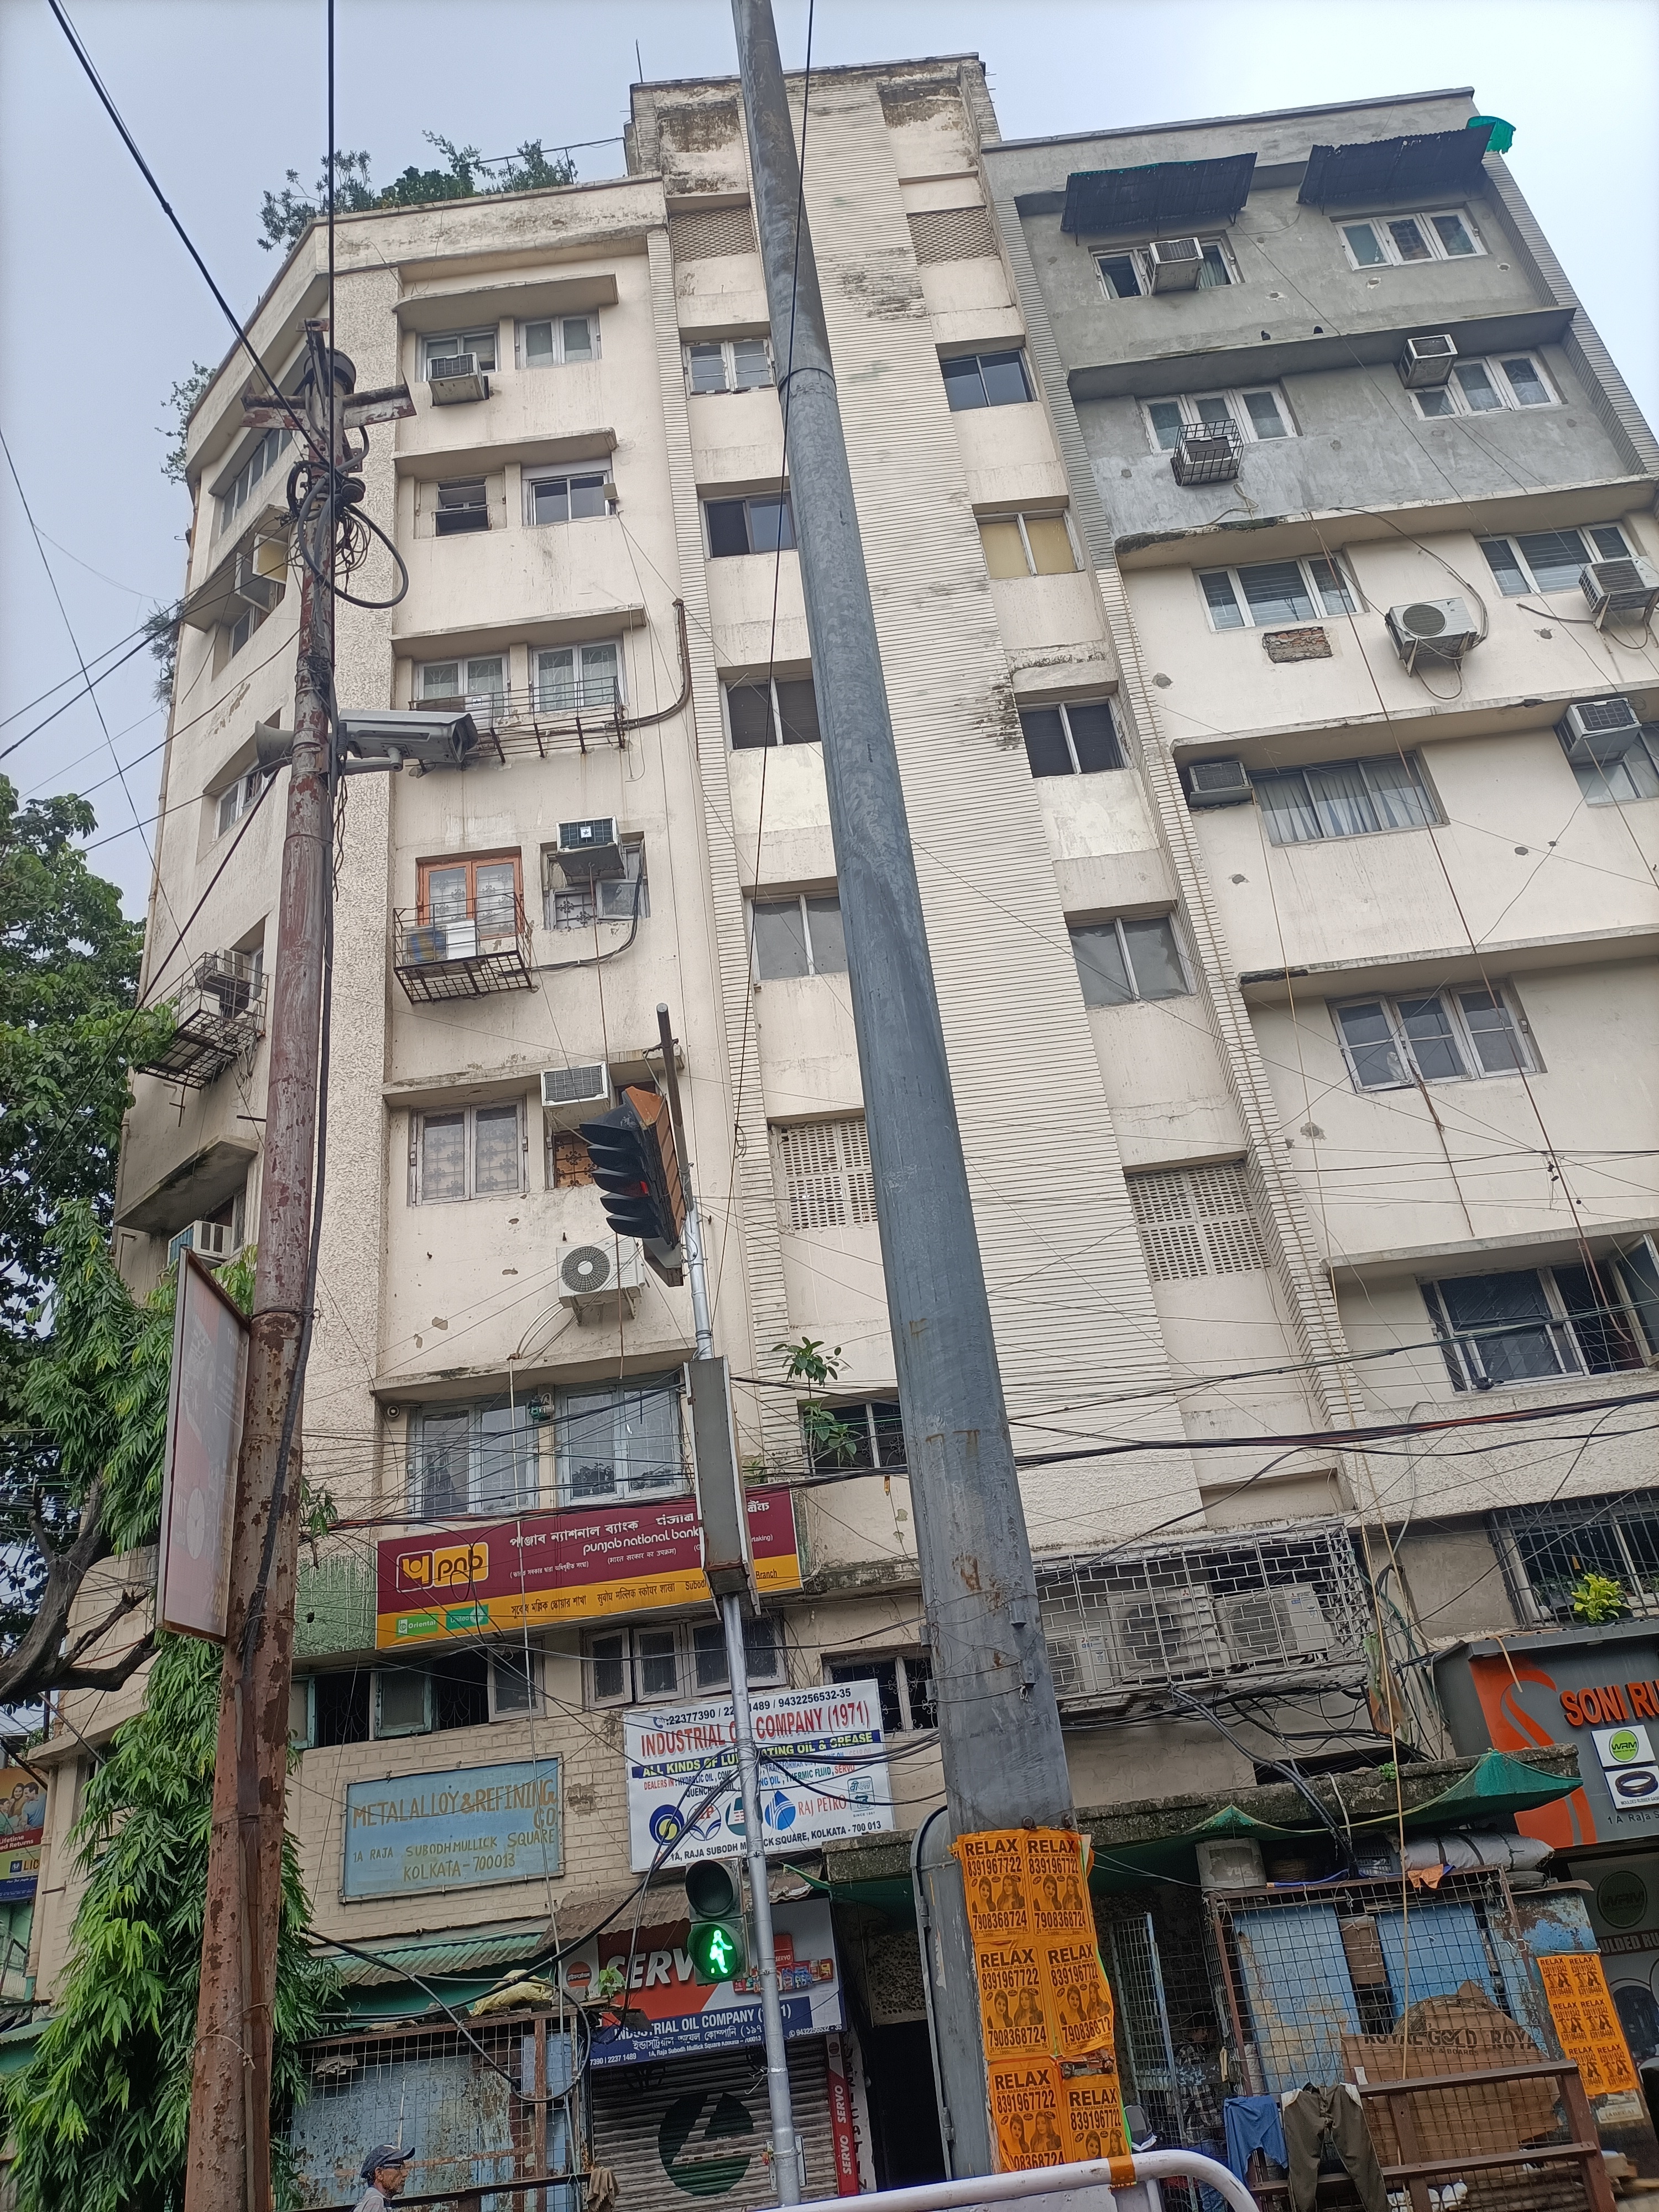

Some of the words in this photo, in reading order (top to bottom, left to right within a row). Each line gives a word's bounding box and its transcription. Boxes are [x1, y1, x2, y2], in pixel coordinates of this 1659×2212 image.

[604, 1520, 639, 1535] ব্যাংক
[751, 1533, 773, 1542] rtaking)
[583, 1537, 622, 1556] punjab
[623, 1530, 670, 1547] national
[671, 1525, 700, 1540] bank
[437, 1549, 483, 1582] pnb
[626, 1553, 644, 1561] सरकार
[755, 1568, 778, 1580] Branch
[660, 1583, 675, 1594] शाखा
[778, 1688, 852, 1708] 9432256532-35
[1559, 1684, 1630, 1728] SONI
[641, 1723, 726, 1757] INDUSTRIAL
[756, 1707, 822, 1739] COMPANY
[828, 1700, 870, 1734] (1971)
[642, 1766, 664, 1777] ALL
[666, 1760, 701, 1774] KINDS
[797, 1742, 815, 1754] OIL
[818, 1740, 827, 1751] &
[830, 1732, 873, 1747] GREASE
[644, 1778, 667, 1790] DEALERS
[798, 1799, 814, 1817] RAJ
[817, 1794, 847, 1813] PETRO
[1628, 1811, 1651, 1823] Raja
[9, 1839, 34, 1849] Returns
[369, 1846, 394, 1861] RAJA
[405, 1840, 451, 1857] SUBODH
[452, 1836, 498, 1853] MULLICK
[507, 1828, 555, 1848] SQUARE
[684, 1848, 705, 1860] RAJA
[706, 1843, 738, 1855] SUBODH
[811, 1826, 847, 1839] KOLKATA
[852, 1822, 866, 1833] 700
[867, 1820, 881, 1831] 013
[964, 1838, 1019, 1857] RELAX
[1027, 1839, 1076, 1854] RELAX
[24, 1859, 39, 1870] LIC
[403, 1860, 462, 1882] KOLKATA
[472, 1853, 516, 1873] 700013
[967, 1856, 1022, 1877] 8391967722
[1028, 1857, 1079, 1875] 8391967722
[972, 1910, 1027, 1931] 7908368724
[1034, 1911, 1086, 1928] 7908368724
[1047, 1943, 1094, 1965] RELAX
[1598, 1935, 1641, 1954] ULDED
[980, 1948, 1036, 1968] RELAX
[1540, 1957, 1564, 1965] RELAX
[1569, 1955, 1594, 1964] RELAX
[607, 1948, 697, 1989] SERV
[1050, 1961, 1098, 1987] 8391967722
[982, 1967, 1040, 1991] 8391967722
[1553, 2001, 1578, 2010] RELAX
[1580, 1999, 1605, 2007] RELAX
[681, 2017, 700, 2031] OIL
[702, 2008, 754, 2028] COMPANY
[1061, 2016, 1112, 2043] 790836872
[988, 2025, 1047, 2047] 7908368724
[608, 2054, 621, 2064] 2237
[623, 2052, 637, 2062] 1489
[667, 2046, 686, 2054] Subodh
[1568, 2046, 1593, 2055] RELAX
[1597, 2043, 1623, 2054] RELAX
[994, 2069, 1051, 2090] RELAX
[834, 2084, 847, 2124] SERVO
[997, 2089, 1056, 2114] 8391967722
[1069, 2088, 1118, 2107] RELAX
[1070, 2107, 1121, 2131] 8391967722
[839, 2135, 852, 2176] SERVO
